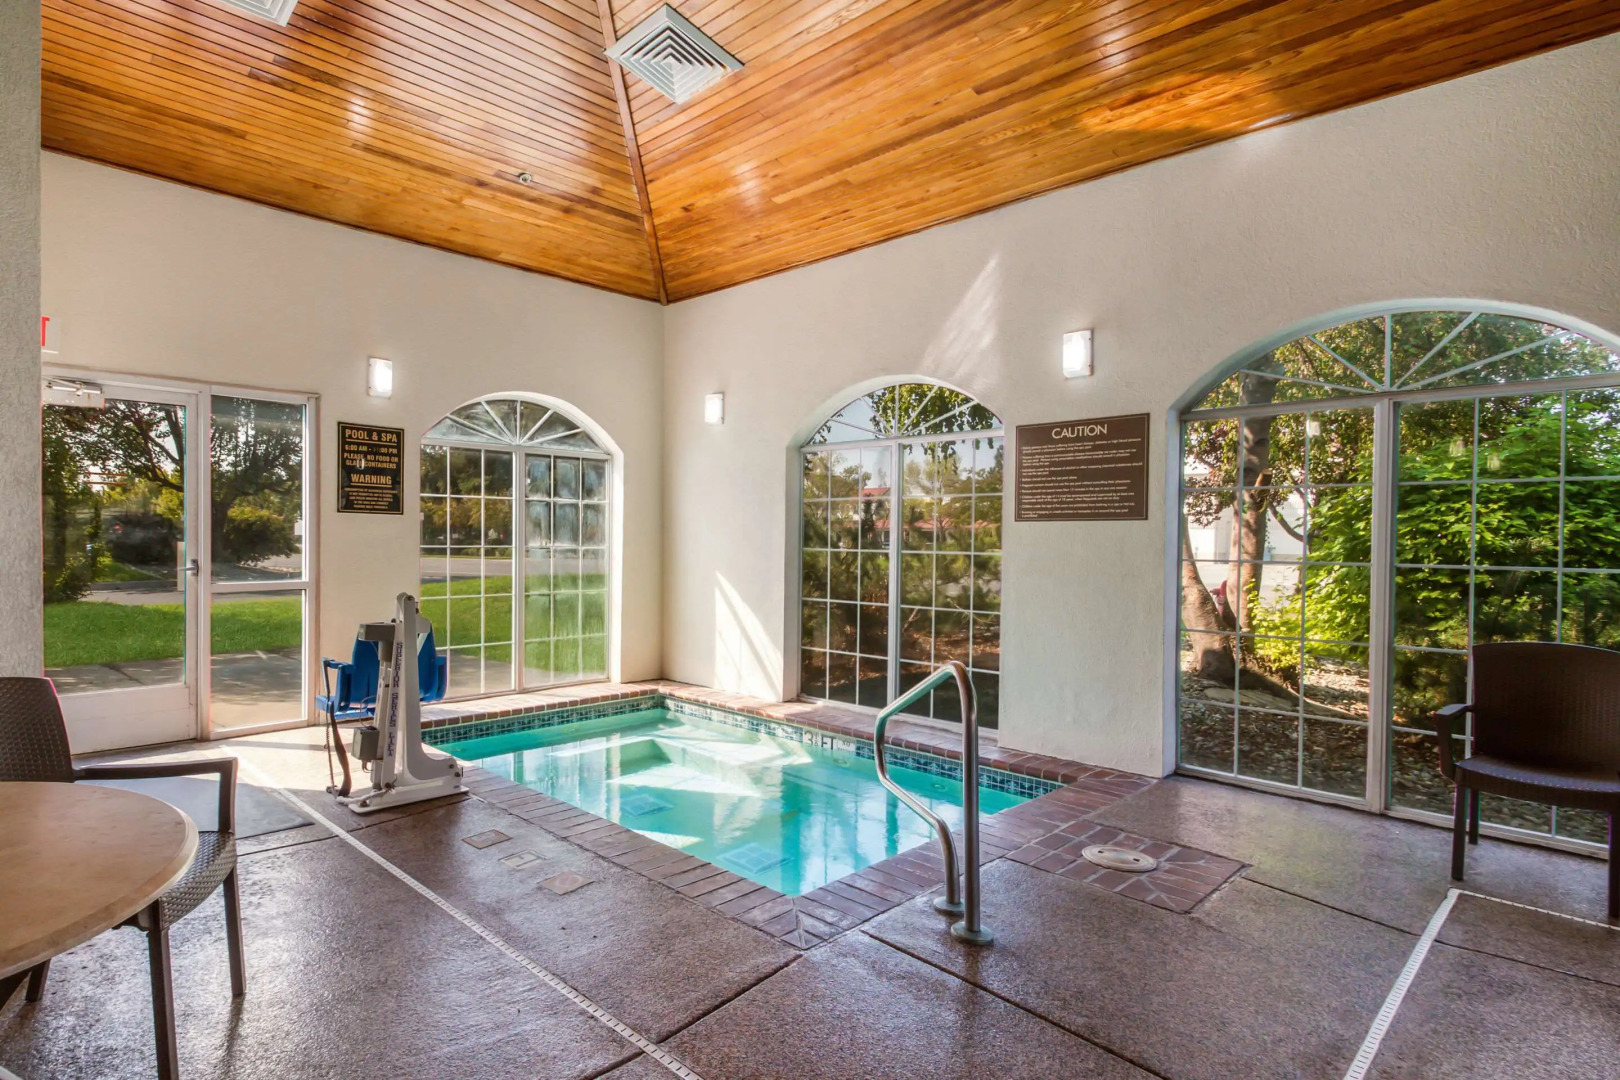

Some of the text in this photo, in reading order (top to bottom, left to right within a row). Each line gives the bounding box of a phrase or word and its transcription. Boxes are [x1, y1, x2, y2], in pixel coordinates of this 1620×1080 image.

[345, 429, 398, 443] POOL & SPA
[1051, 424, 1107, 439] CAUTION
[364, 461, 397, 469] CONTAINERS
[351, 473, 392, 484] WARNING
[820, 735, 836, 750] FT
